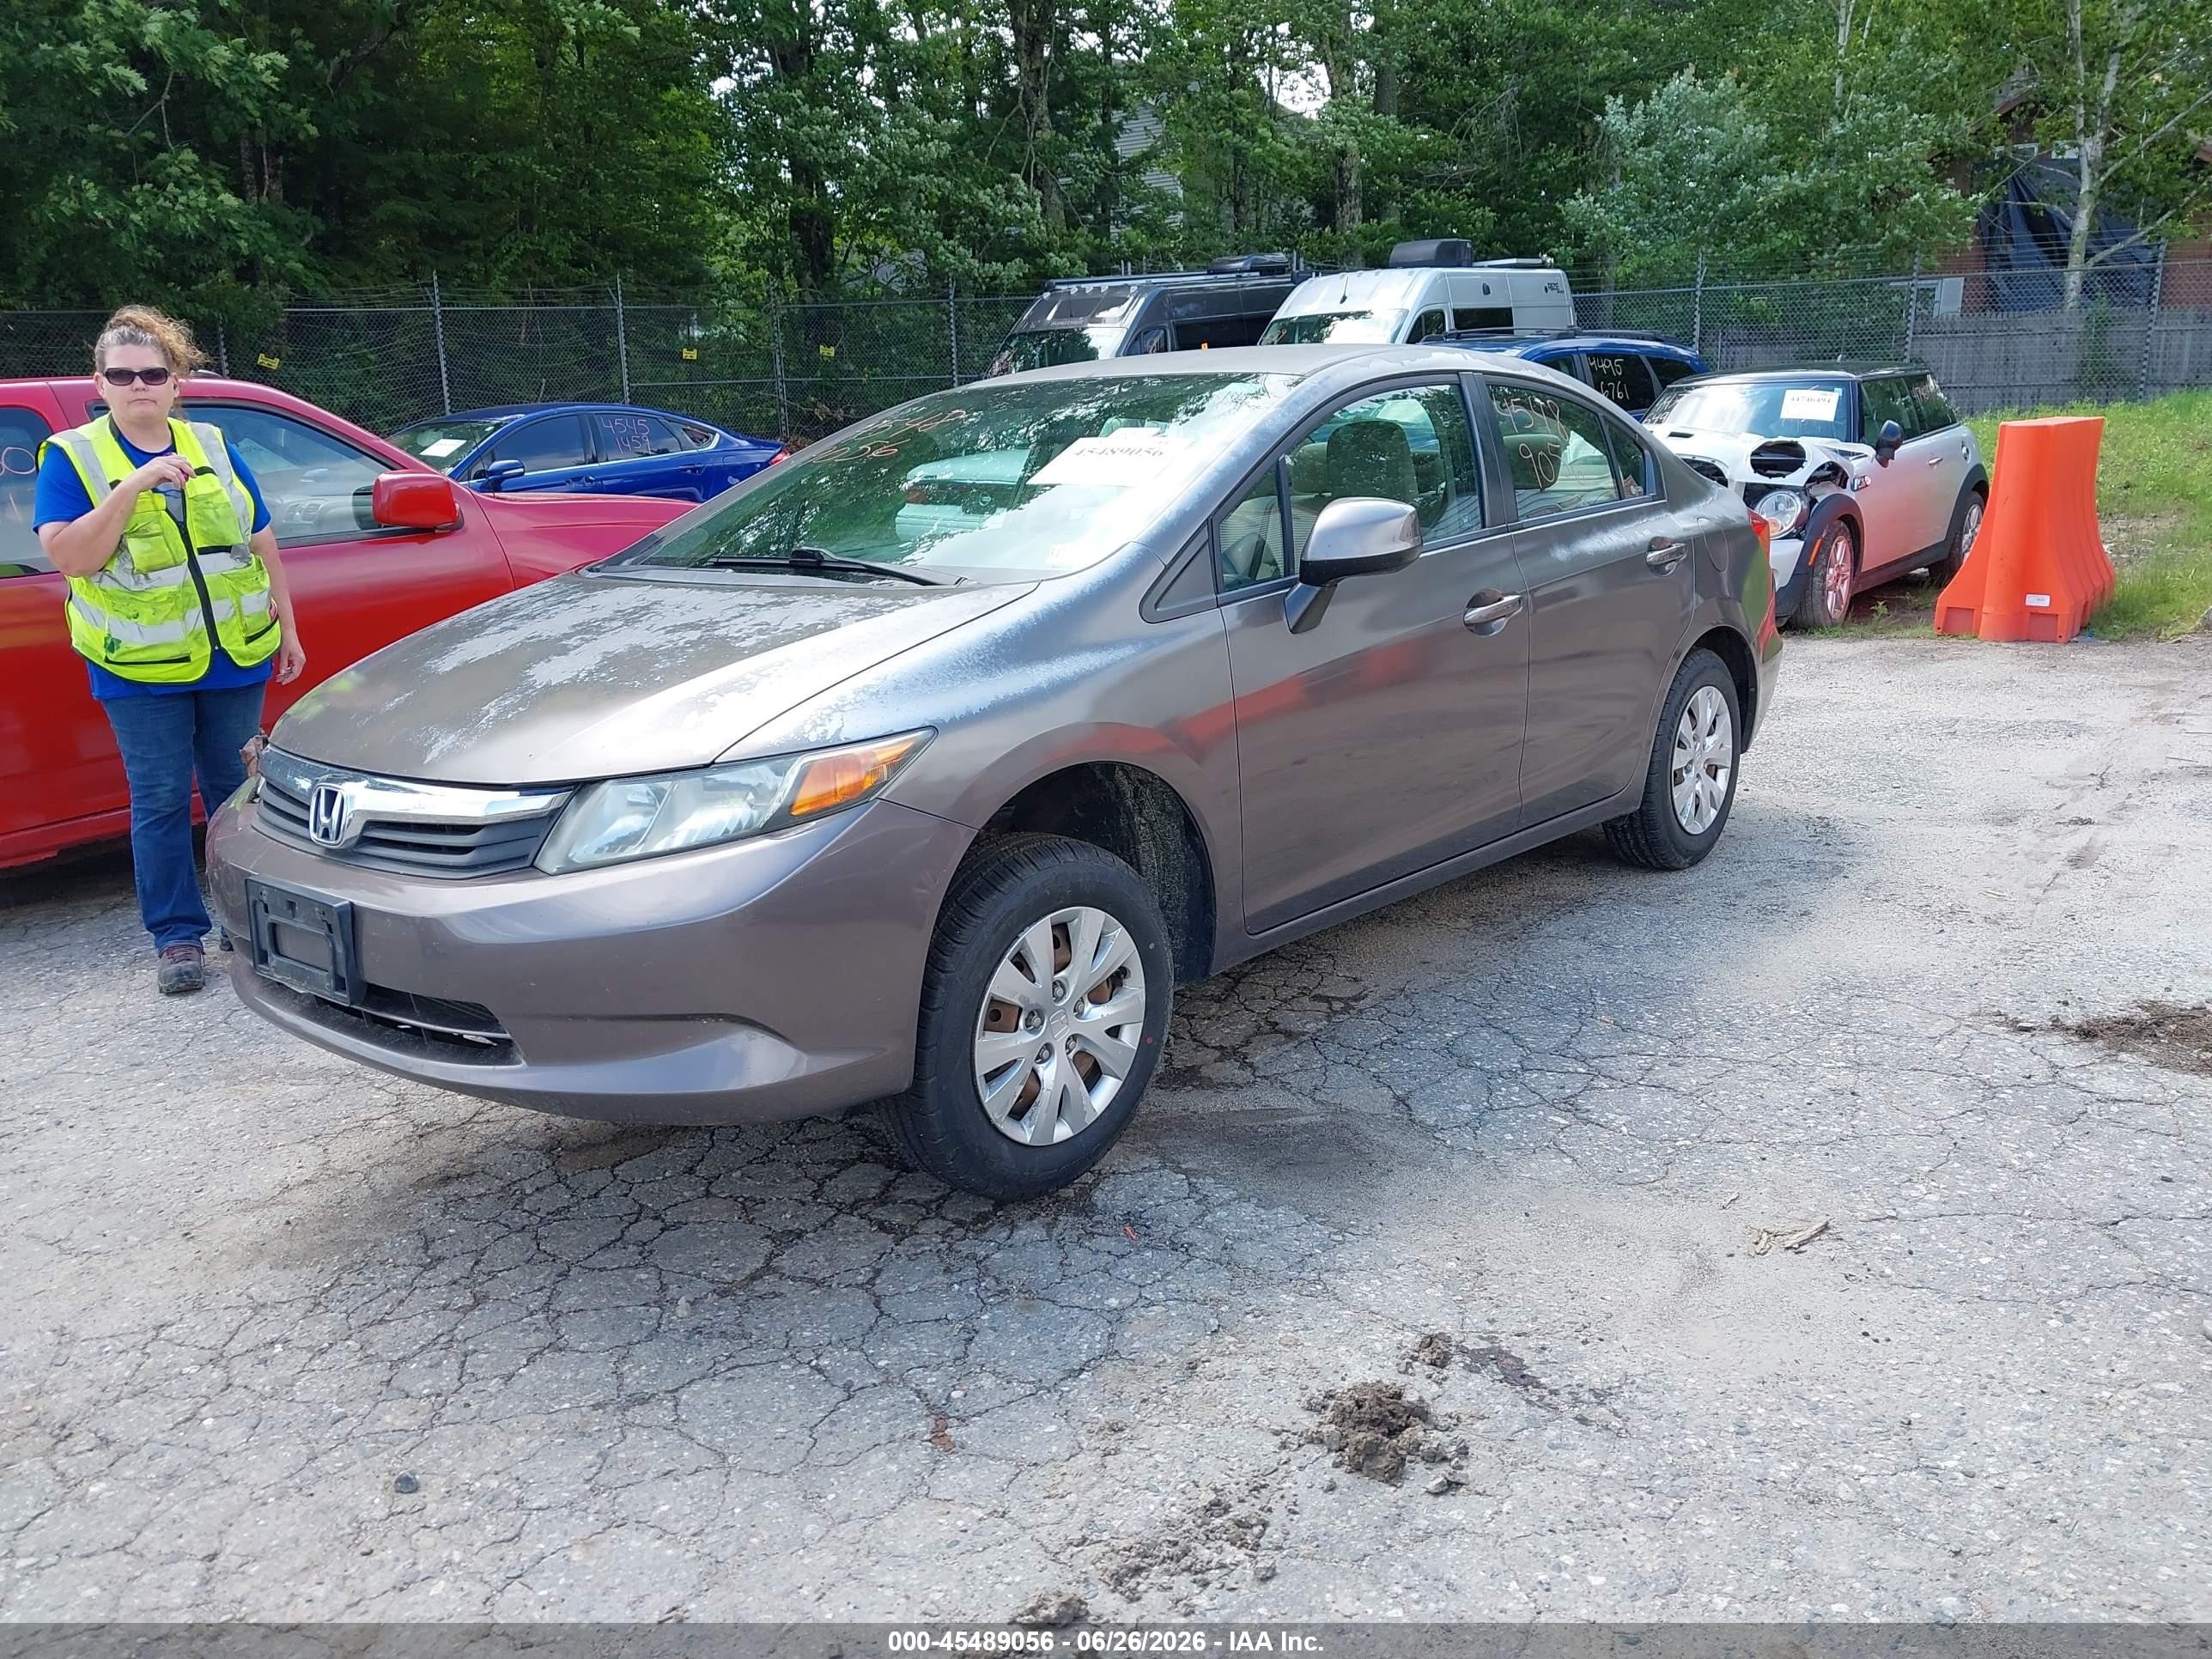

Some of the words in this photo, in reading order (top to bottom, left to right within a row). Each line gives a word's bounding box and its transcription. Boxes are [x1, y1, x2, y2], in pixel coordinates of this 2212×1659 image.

[1588, 356, 1624, 376] 4495
[1600, 380, 1630, 401] 6761
[1491, 389, 1569, 441] 4548
[600, 416, 651, 436] 4545
[615, 434, 652, 454] 1459
